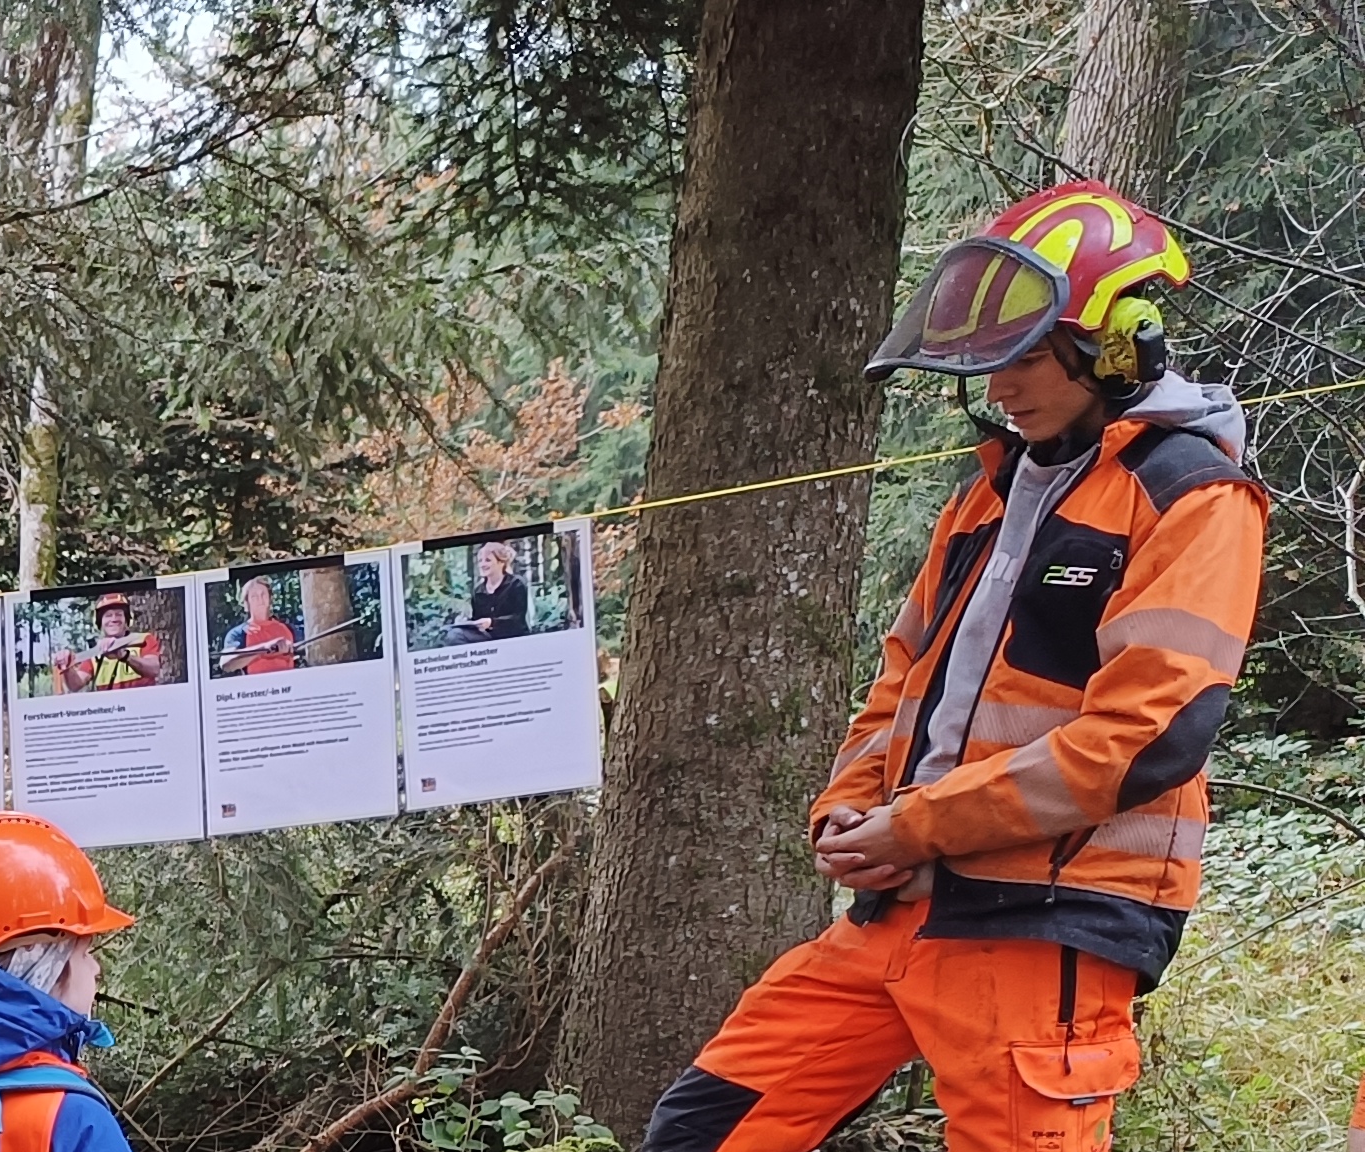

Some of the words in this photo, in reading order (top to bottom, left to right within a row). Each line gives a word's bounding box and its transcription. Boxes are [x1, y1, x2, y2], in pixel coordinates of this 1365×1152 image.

[414, 654, 450, 666] Bachelor
[452, 651, 468, 659] und
[470, 648, 498, 657] Master
[424, 658, 488, 673] Forstwirtschaft
[216, 693, 235, 702] Dipl.
[281, 686, 291, 694] HF
